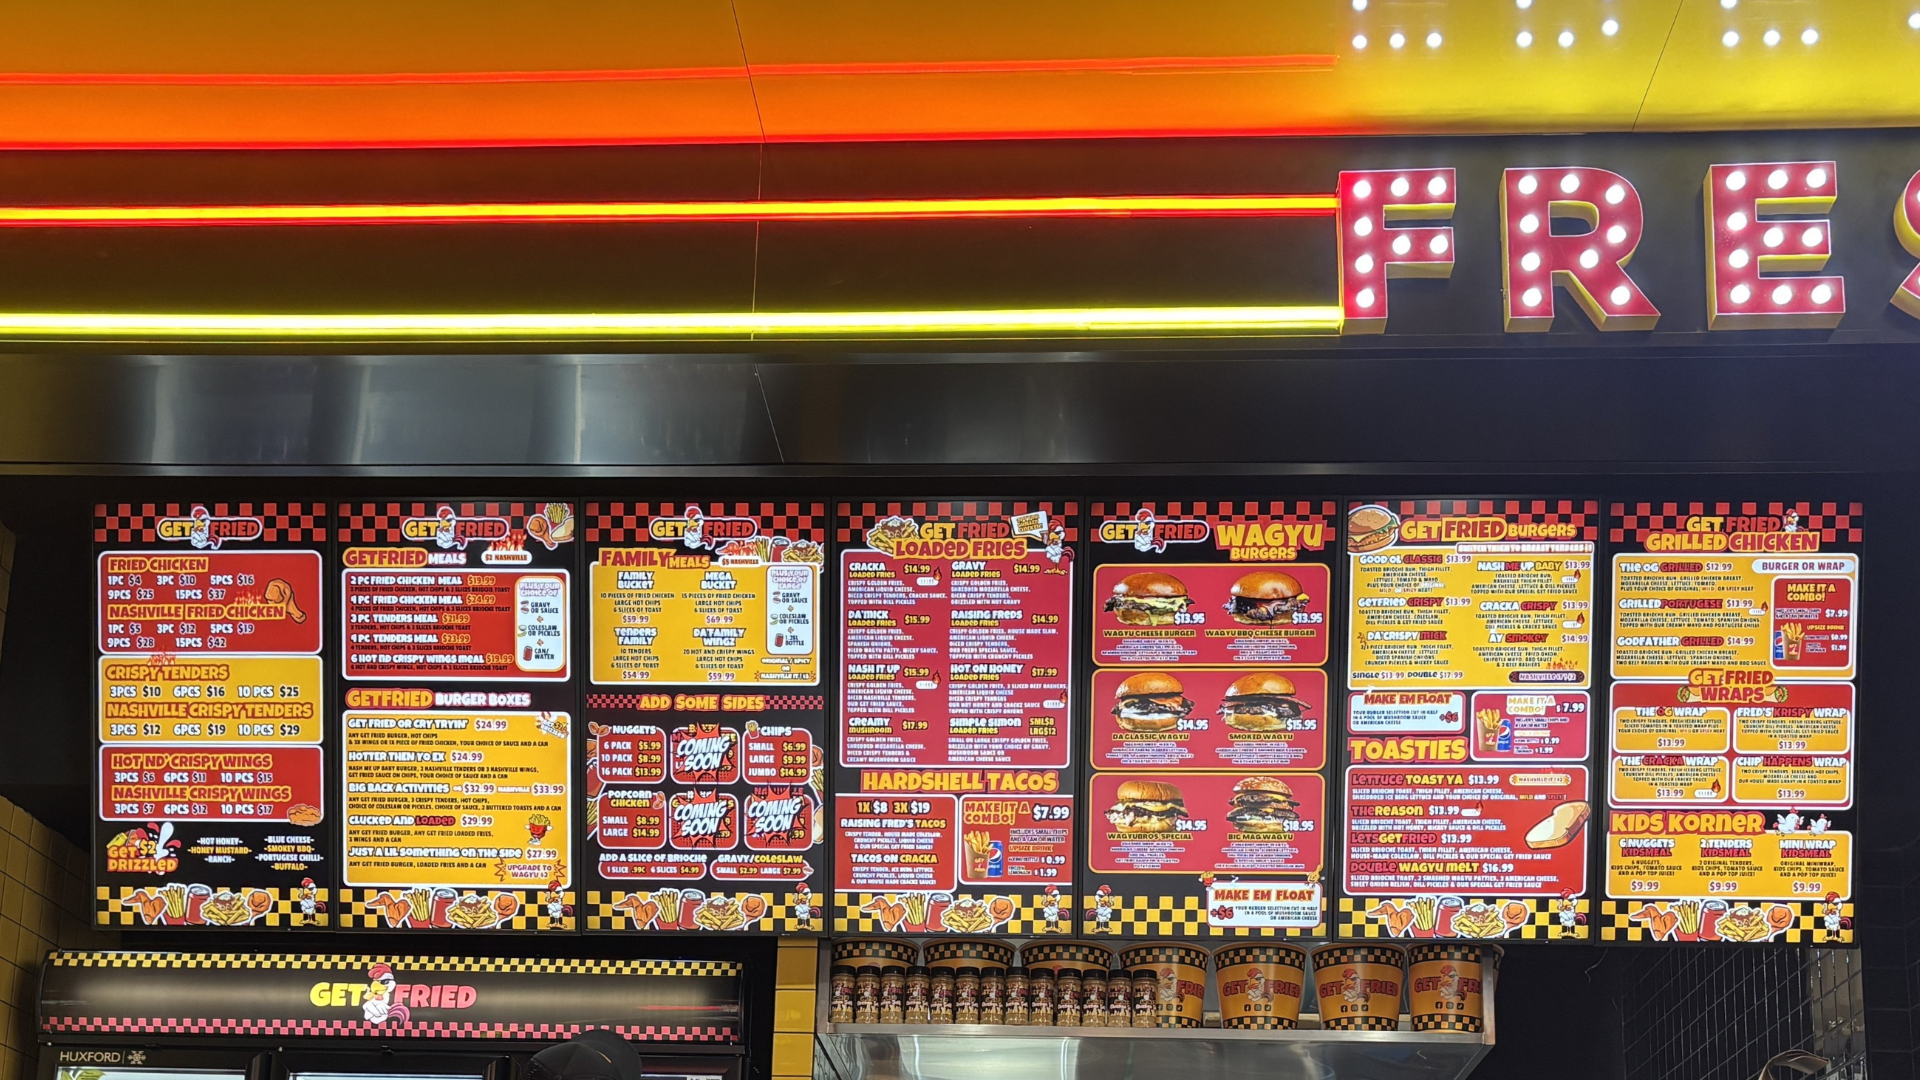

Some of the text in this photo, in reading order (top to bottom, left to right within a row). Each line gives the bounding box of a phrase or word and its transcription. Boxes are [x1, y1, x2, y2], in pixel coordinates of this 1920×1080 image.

[1340, 162, 1920, 331] FRE
[160, 522, 258, 536] GET FRIED
[404, 522, 505, 537] GET FRIED
[653, 522, 754, 537] GET FRIED
[920, 523, 955, 538] GET
[958, 523, 1010, 538] FRIED
[1401, 521, 1440, 539] GET
[1445, 521, 1504, 538] FRIED
[1687, 517, 1780, 532] GET FRIED
[1102, 525, 1206, 539] GET FRIED
[1217, 524, 1323, 545] WAGYU
[1647, 534, 1818, 550] GRILLED CHICKEN
[110, 558, 207, 571] FRIED CHICKEN
[429, 553, 466, 564] MEALS
[600, 551, 710, 568] FAMILY MEALS
[1446, 555, 1471, 563] $13.99
[849, 563, 930, 573] CRACKA $14.99
[952, 562, 1040, 573] GRAVY $14.99
[1762, 562, 1844, 571] BURGER OR WRAP
[108, 575, 254, 584] 1PC $4 3PC $10 5PCS $16
[1787, 593, 1825, 601] COMBO!
[109, 606, 284, 618] NASHVILLE FRIED CHICKEN
[1480, 602, 1588, 611] CRACKA CRISPY $13.99
[623, 615, 649, 623] $59.99
[1174, 613, 1205, 624] $13.95
[1292, 613, 1323, 624] $13.95
[107, 666, 228, 679] CRISPY TENDERS
[1689, 672, 1773, 684] GET FRIED
[110, 686, 299, 698] 3PCS $10 6PCS $16 10 PCS $25
[1701, 687, 1765, 700] WRAPS
[435, 693, 486, 706] BURGER
[489, 694, 530, 706] BOXES
[640, 697, 764, 709] ADD SOME SIDES
[1364, 694, 1451, 704] MAKE EM FLOAT
[107, 704, 312, 718] NASHVILLE CRISPY TENDERS
[1774, 708, 1812, 717] KRISPY
[1814, 708, 1846, 717] WRAP
[475, 720, 507, 729] $24.99
[613, 725, 656, 734] NUGGETS
[1177, 721, 1209, 730] $14.95
[1286, 721, 1317, 730] $15.95
[761, 726, 791, 736] CHIPS
[604, 741, 661, 750] 6 PACK $5.99
[678, 736, 730, 755] COMING
[749, 742, 806, 751] SMALL $6.99
[1350, 740, 1466, 759] TOASTIES
[114, 756, 142, 769] HOT
[172, 756, 222, 769] CRISPY
[224, 756, 270, 768] WINGS
[685, 753, 722, 771] SOON
[782, 755, 806, 764] $9.99
[1737, 757, 1846, 766] CHIP HAPPENS WRAP
[749, 768, 806, 776] JUMBO $14.99
[863, 773, 1058, 790] HARDSHELL TACOS
[1406, 775, 1499, 784] TOAST YA $13.99
[675, 801, 727, 820] COMING
[749, 799, 802, 817] COMING
[857, 801, 930, 813] 1X $8 3X $19
[965, 803, 1029, 812] MAKE IT A
[965, 805, 1070, 823] COMBO! $7.99
[682, 818, 717, 836] SOON
[757, 815, 793, 832] SOON
[841, 819, 880, 827] RAISING
[915, 819, 946, 827] TACOS
[1283, 821, 1314, 831] $18.95
[1612, 814, 1664, 831] KIDS
[1482, 863, 1513, 872] $16.99
[1631, 881, 1659, 891] $9.99
[1709, 882, 1737, 891] $9.99
[1793, 882, 1821, 892] $9.99
[1215, 890, 1314, 900] MAKE EM FLOAT
[1223, 980, 1248, 995] GET
[1320, 980, 1344, 998] GET
[1415, 977, 1440, 992] GET
[310, 982, 476, 1008] GET FRIED
[60, 1051, 120, 1062] HUXFORD
